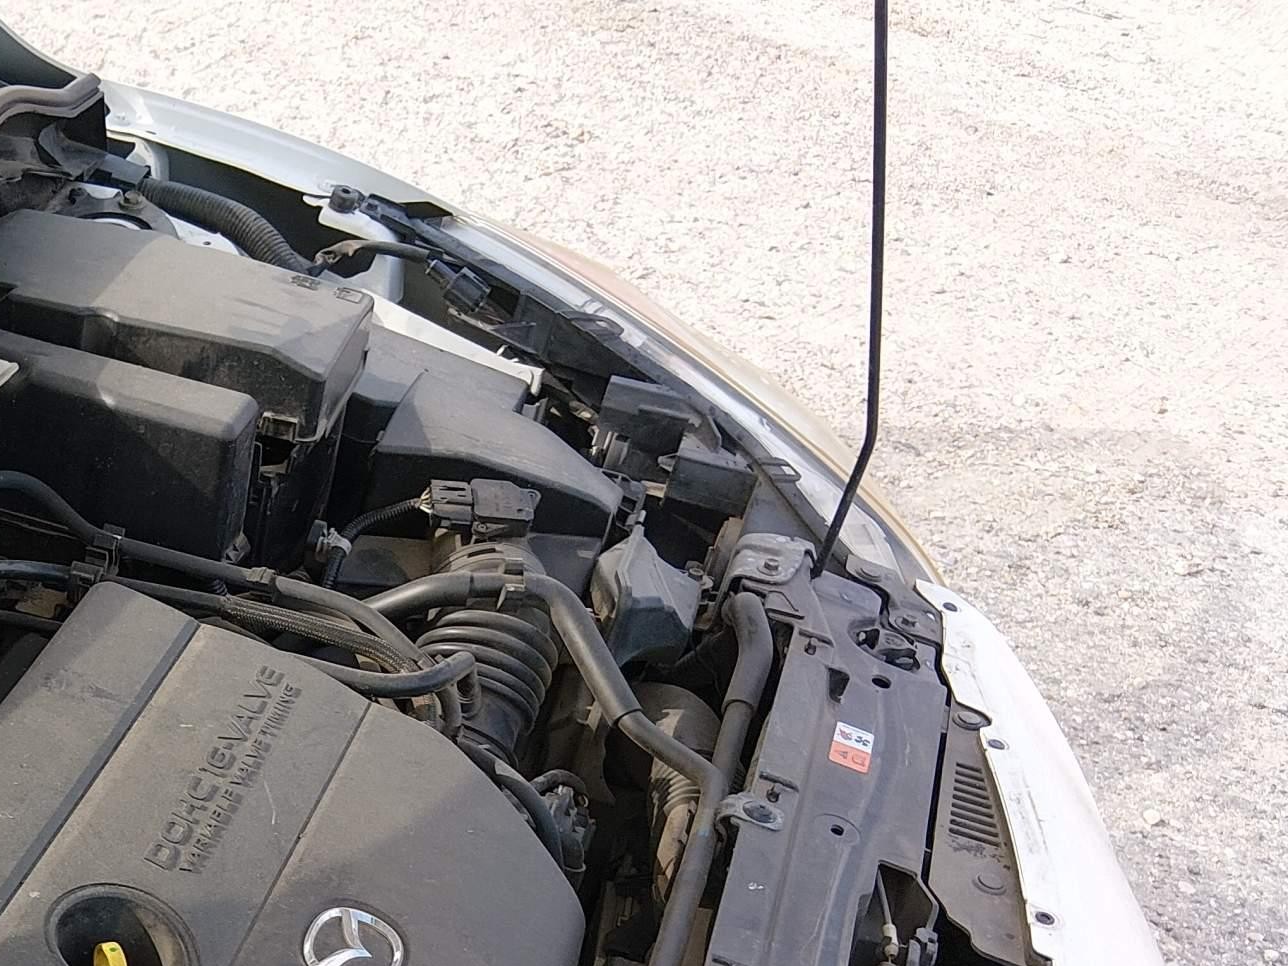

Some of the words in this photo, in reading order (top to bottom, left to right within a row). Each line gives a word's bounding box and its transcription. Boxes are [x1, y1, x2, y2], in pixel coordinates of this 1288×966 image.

[144, 775, 219, 871] DOHC
[198, 666, 286, 778] 16-VALVE
[179, 788, 243, 873] VARIABLE
[230, 738, 272, 788] VALVE
[259, 683, 302, 738] TIMING
